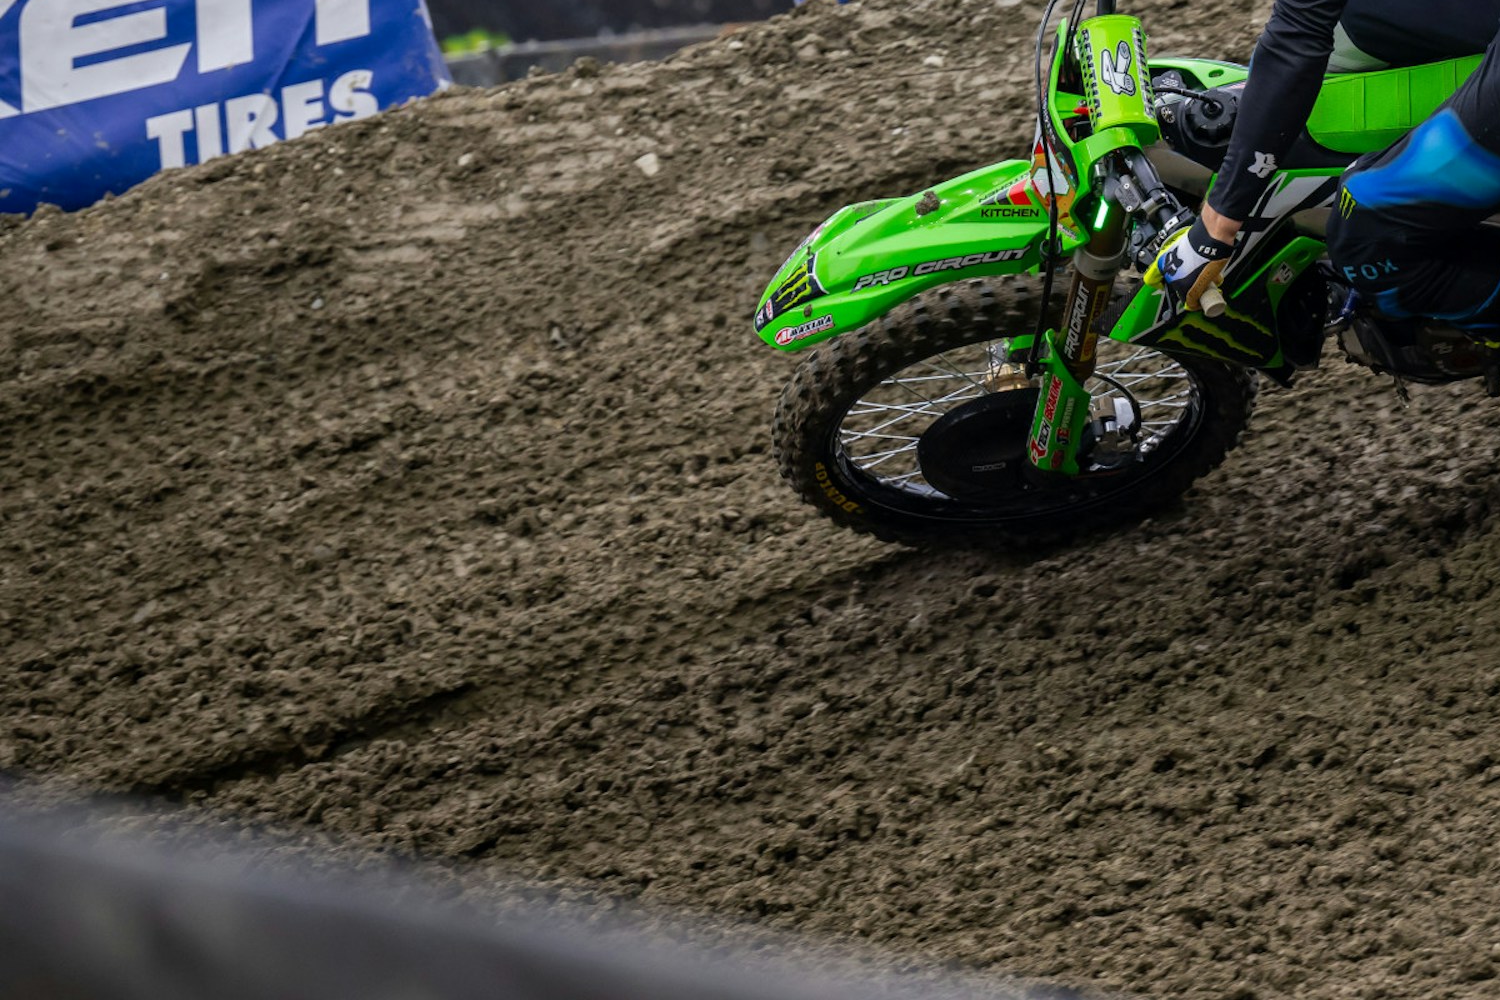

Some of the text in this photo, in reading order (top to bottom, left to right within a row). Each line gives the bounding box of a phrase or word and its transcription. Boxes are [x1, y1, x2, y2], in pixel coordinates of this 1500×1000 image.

[146, 69, 378, 170] TIRES
[981, 208, 1040, 218] KITCHEN
[1198, 246, 1217, 257] FOX
[851, 245, 1032, 294] PRO CIRCUIT
[1343, 258, 1400, 283] FOX
[1070, 280, 1091, 332] CIRCUIT
[789, 315, 833, 337] MAXIMA
[1064, 330, 1080, 360] PRO
[815, 461, 860, 513] DUNLOP
